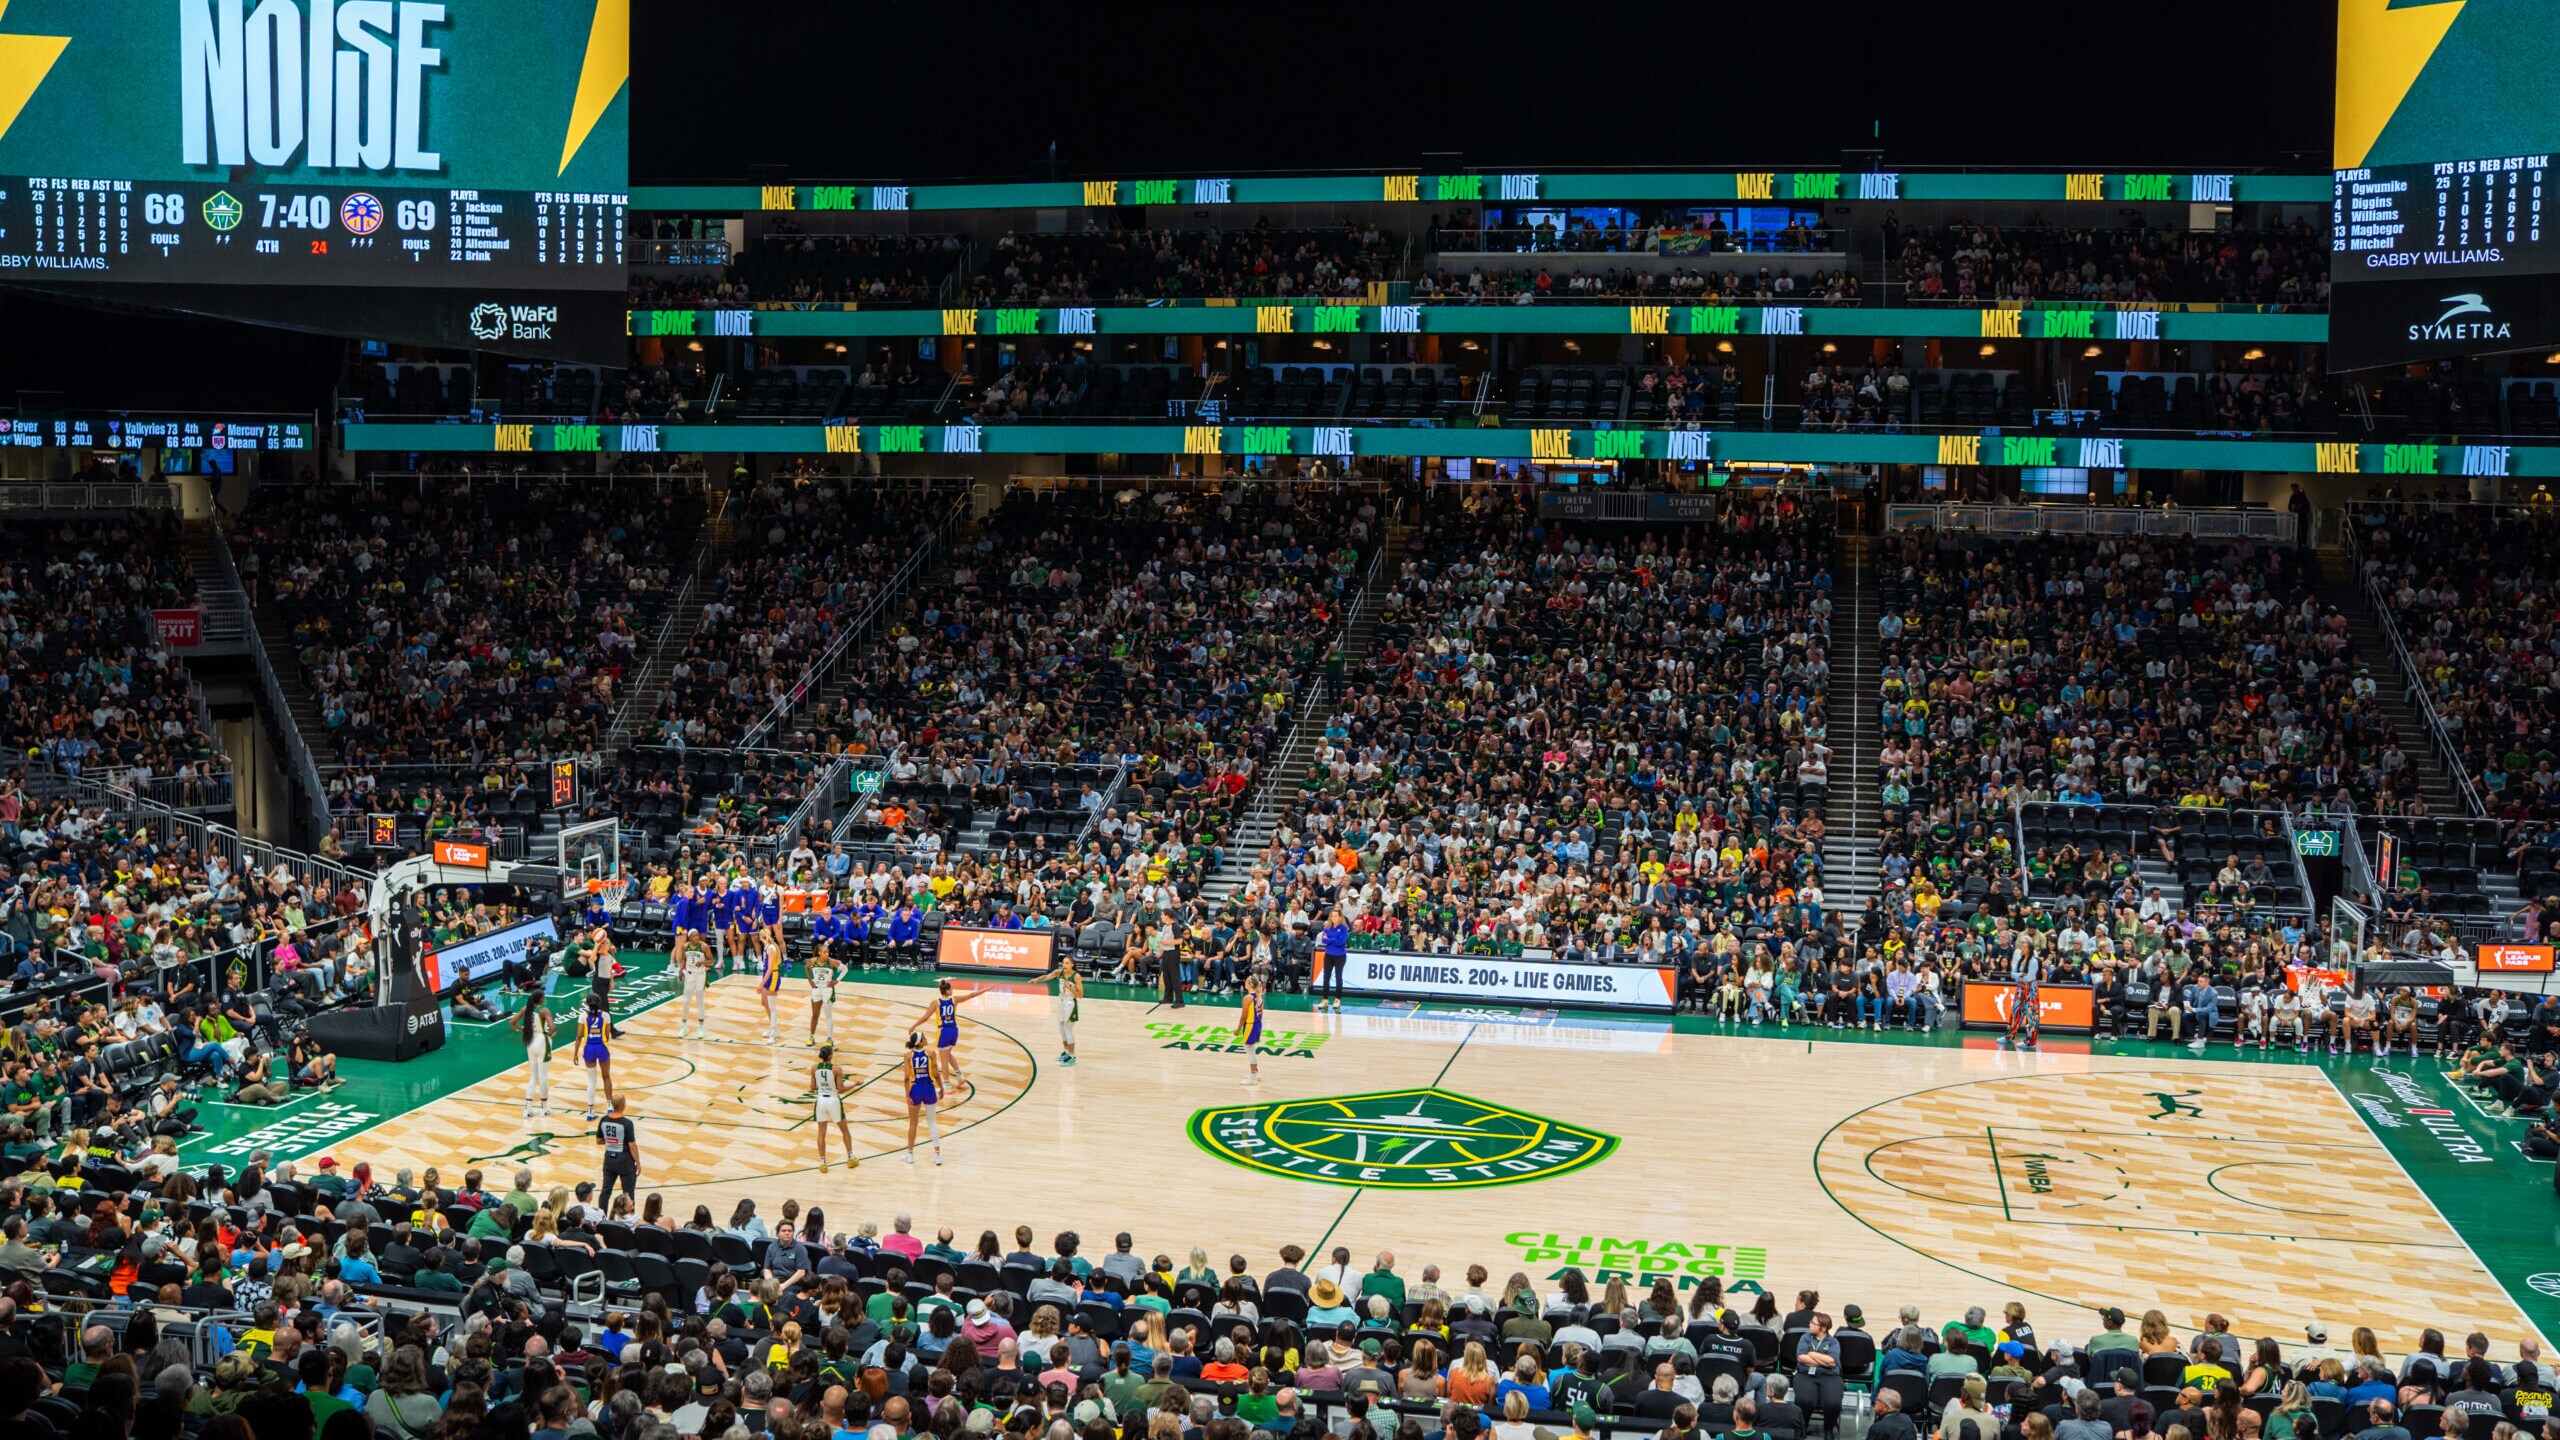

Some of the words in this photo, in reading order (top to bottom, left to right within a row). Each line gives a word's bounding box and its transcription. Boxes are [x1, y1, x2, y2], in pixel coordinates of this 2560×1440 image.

[180, 0, 446, 171] NOISE
[2335, 168, 2370, 182] PLAYER
[2434, 163, 2453, 175] PTS
[2458, 161, 2475, 173] FLS
[2480, 160, 2500, 171] REB
[2503, 157, 2524, 170] AST
[2527, 156, 2548, 168] BLK
[29, 178, 47, 188] PTS
[52, 179, 67, 189] FLS
[72, 180, 90, 190] REB
[93, 180, 111, 190] AST
[114, 181, 131, 191] BLK
[1384, 175, 1419, 201] MAKE
[1437, 175, 1483, 201] SOME
[1501, 174, 1540, 200] NOISE
[2066, 174, 2104, 201] MAKE
[2123, 174, 2173, 201] SOME
[2192, 174, 2234, 202] NOISE
[2352, 180, 2407, 195] Ogwumike
[451, 190, 478, 200] PLAYER
[535, 192, 552, 202] PTS
[556, 193, 570, 203] FLS
[574, 194, 590, 203] REB
[592, 194, 609, 204] AST
[612, 195, 628, 204] BLK
[762, 186, 795, 211] MAKE
[813, 186, 856, 211] SOME
[873, 186, 909, 211] NOISE
[2352, 197, 2392, 211] Diggins
[145, 194, 184, 224] 68
[259, 195, 330, 229] 7:40
[465, 202, 502, 213] Jackson
[398, 200, 435, 230] 69
[451, 215, 461, 224] 10
[466, 214, 489, 224] Plum
[2352, 210, 2398, 222] Williams
[451, 226, 461, 236] 12
[466, 226, 497, 237] Burrell
[2334, 226, 2345, 237] 13
[2351, 224, 2404, 236] Magbegor
[152, 234, 179, 244] FOULS
[256, 240, 279, 252] 4TH
[403, 239, 429, 249] FOULS
[451, 238, 461, 248] 20
[465, 238, 509, 249] Allemand
[2334, 240, 2345, 250] 25
[2351, 237, 2393, 250] Mitchell
[312, 241, 327, 254] 24
[451, 250, 461, 260] 22
[466, 251, 490, 260] Brink
[2367, 253, 2420, 267] GABBY
[2424, 249, 2503, 264] WILLIAMS.
[35, 256, 108, 269] WILLIAMS.
[511, 306, 556, 321] WaFd
[1631, 306, 1669, 334] MAKE
[1690, 306, 1742, 334] SOME
[1761, 307, 1804, 335] NOISE
[651, 310, 696, 336] SOME
[715, 310, 753, 336] NOISE
[943, 309, 978, 336] MAKE
[995, 308, 1041, 335] SOME
[1058, 307, 1096, 334] NOISE
[1982, 309, 2022, 338] MAKE
[2043, 310, 2096, 338] SOME
[2116, 310, 2161, 340] NOISE
[513, 324, 551, 339] Bank
[2409, 323, 2510, 340] SYMETRA
[13, 420, 38, 432] Fever
[55, 422, 66, 433] 88
[75, 422, 88, 431] 4th
[125, 423, 165, 437] Valkyries
[167, 424, 177, 434] 73
[185, 424, 198, 433] 4th
[228, 424, 264, 439] Mercury
[268, 425, 278, 436] 72
[286, 425, 299, 435] 4th
[13, 434, 42, 447] Wings
[56, 435, 66, 446] 78
[126, 436, 142, 448] Sky
[167, 437, 178, 447] 66
[228, 437, 256, 448] Dream
[268, 438, 279, 449] 95
[495, 424, 532, 451] MAKE
[553, 424, 602, 451] SOME
[621, 425, 661, 452] NOISE
[1184, 426, 1222, 455] MAKE
[1243, 426, 1292, 455] SOME
[1312, 427, 1354, 455] NOISE
[1939, 435, 1981, 465] MAKE
[2003, 436, 2056, 467] SOME
[2079, 437, 2125, 469] NOISE
[2316, 442, 2360, 473] MAKE
[2383, 444, 2439, 475] SOME
[2462, 445, 2511, 476] NOISE
[1565, 505, 1584, 514] CLUB
[1669, 499, 1710, 507] SYMETRA
[1678, 508, 1699, 516] CLUB
[158, 625, 194, 638] EXIT
[557, 764, 572, 776] 7:40
[554, 779, 572, 802] 24
[377, 818, 393, 829] 7:40
[376, 830, 390, 842] 24
[983, 938, 1008, 946] WNBA
[983, 945, 1028, 954] LEAGUE
[983, 952, 1012, 960] PASS
[1368, 963, 1395, 980] BIG
[1400, 965, 1463, 984] NAMES.
[1469, 968, 1508, 987] 200+
[1514, 971, 1549, 989] LIVE
[1553, 973, 1618, 992] GAMES.
[942, 1005, 953, 1016] 10
[418, 1012, 439, 1030] AT&T
[591, 1018, 598, 1028] 2
[914, 1057, 928, 1069] 12
[820, 1071, 827, 1082] 4
[207, 1102, 359, 1155] SEATTLE
[261, 1112, 381, 1153] STORM
[606, 1126, 616, 1137] 29
[2420, 1118, 2493, 1163] ULTRA
[1221, 1116, 1387, 1180] SEATTLE
[1432, 1137, 1584, 1182] STORM
[2024, 1160, 2053, 1193] WNBA
[2201, 1376, 2215, 1391] 32
[1566, 1388, 1588, 1407] 54
